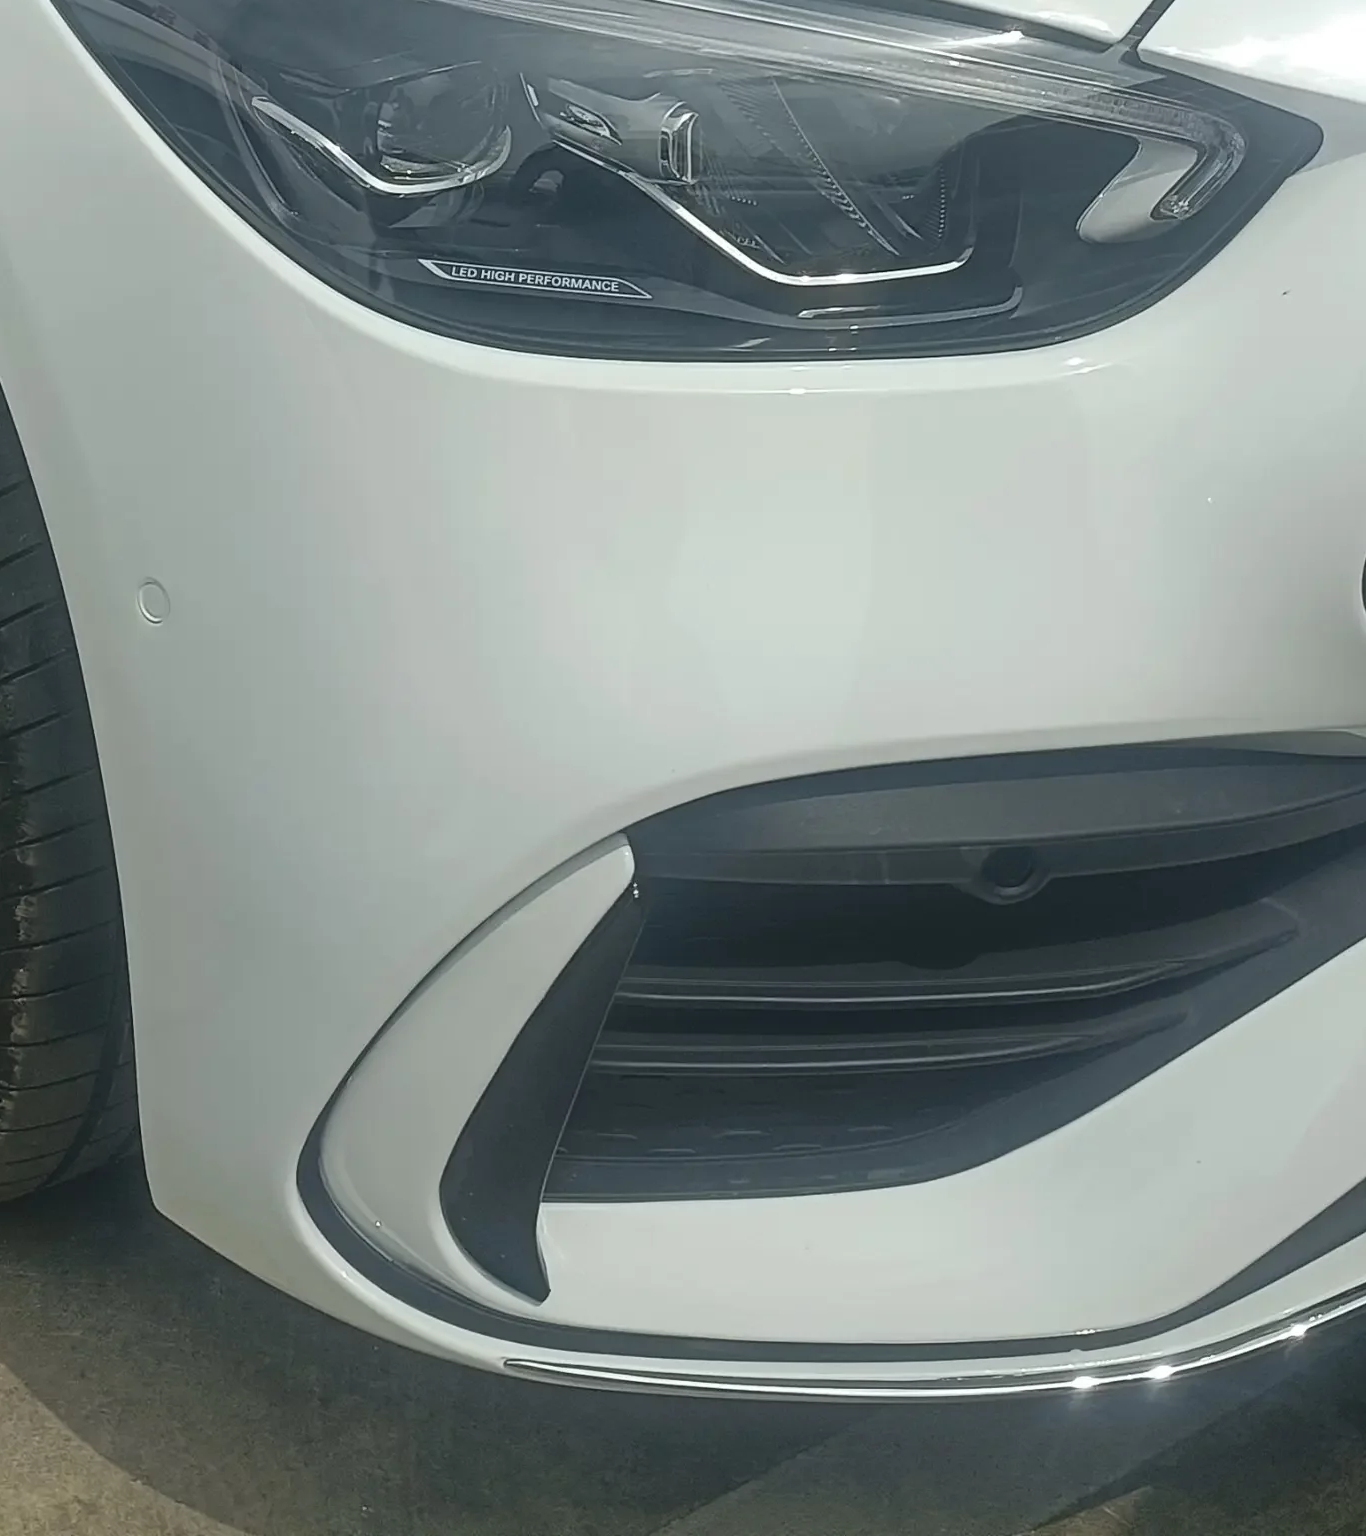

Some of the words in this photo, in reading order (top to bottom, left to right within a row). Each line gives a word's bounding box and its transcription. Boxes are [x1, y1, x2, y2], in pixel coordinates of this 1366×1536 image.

[451, 266, 478, 278] LED
[480, 269, 515, 282] HIGH
[518, 273, 620, 292] PERFORMANCE
